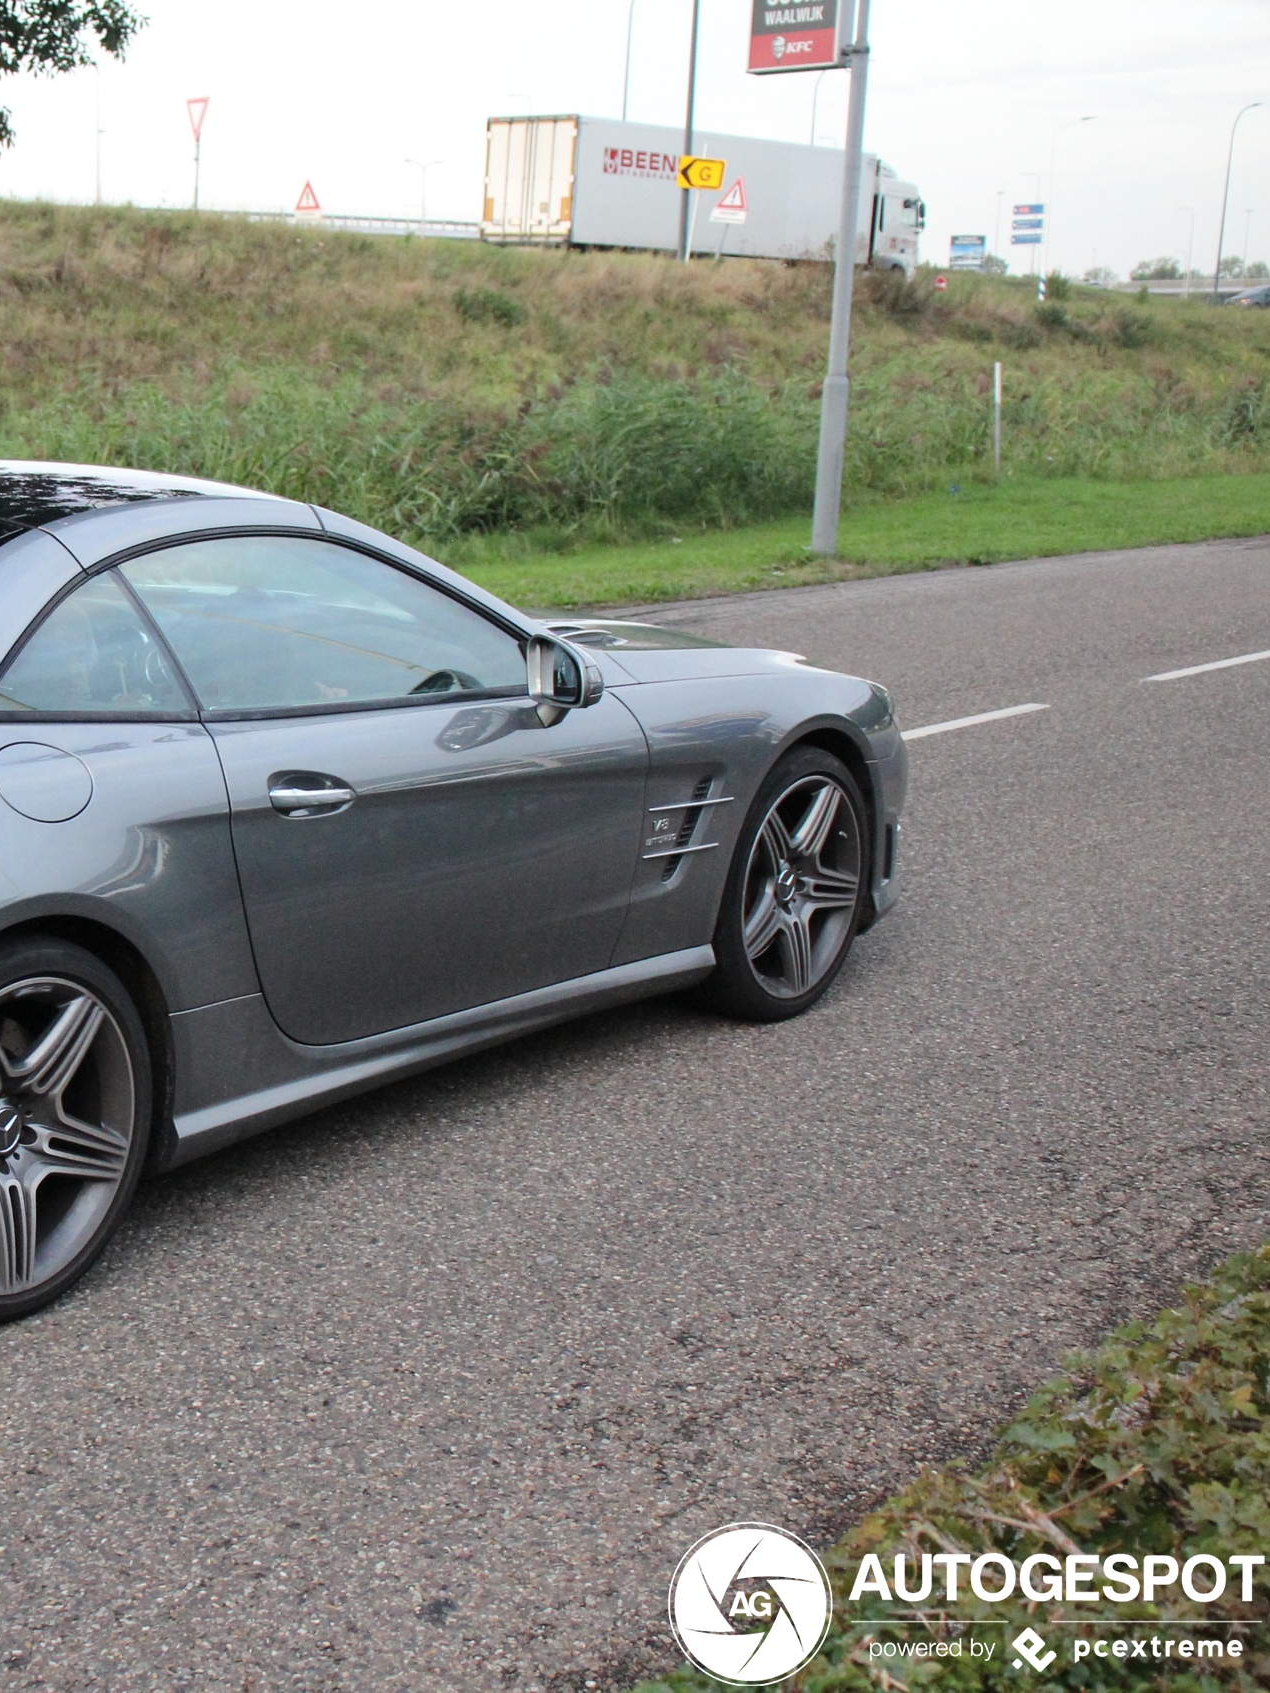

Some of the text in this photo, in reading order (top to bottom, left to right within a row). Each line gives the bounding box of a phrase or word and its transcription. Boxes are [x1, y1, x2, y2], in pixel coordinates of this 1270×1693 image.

[765, 6, 823, 25] WAALWIJK
[785, 40, 814, 54] KFC
[620, 149, 681, 173] BEEN
[699, 166, 712, 182] G
[653, 818, 670, 832] V8
